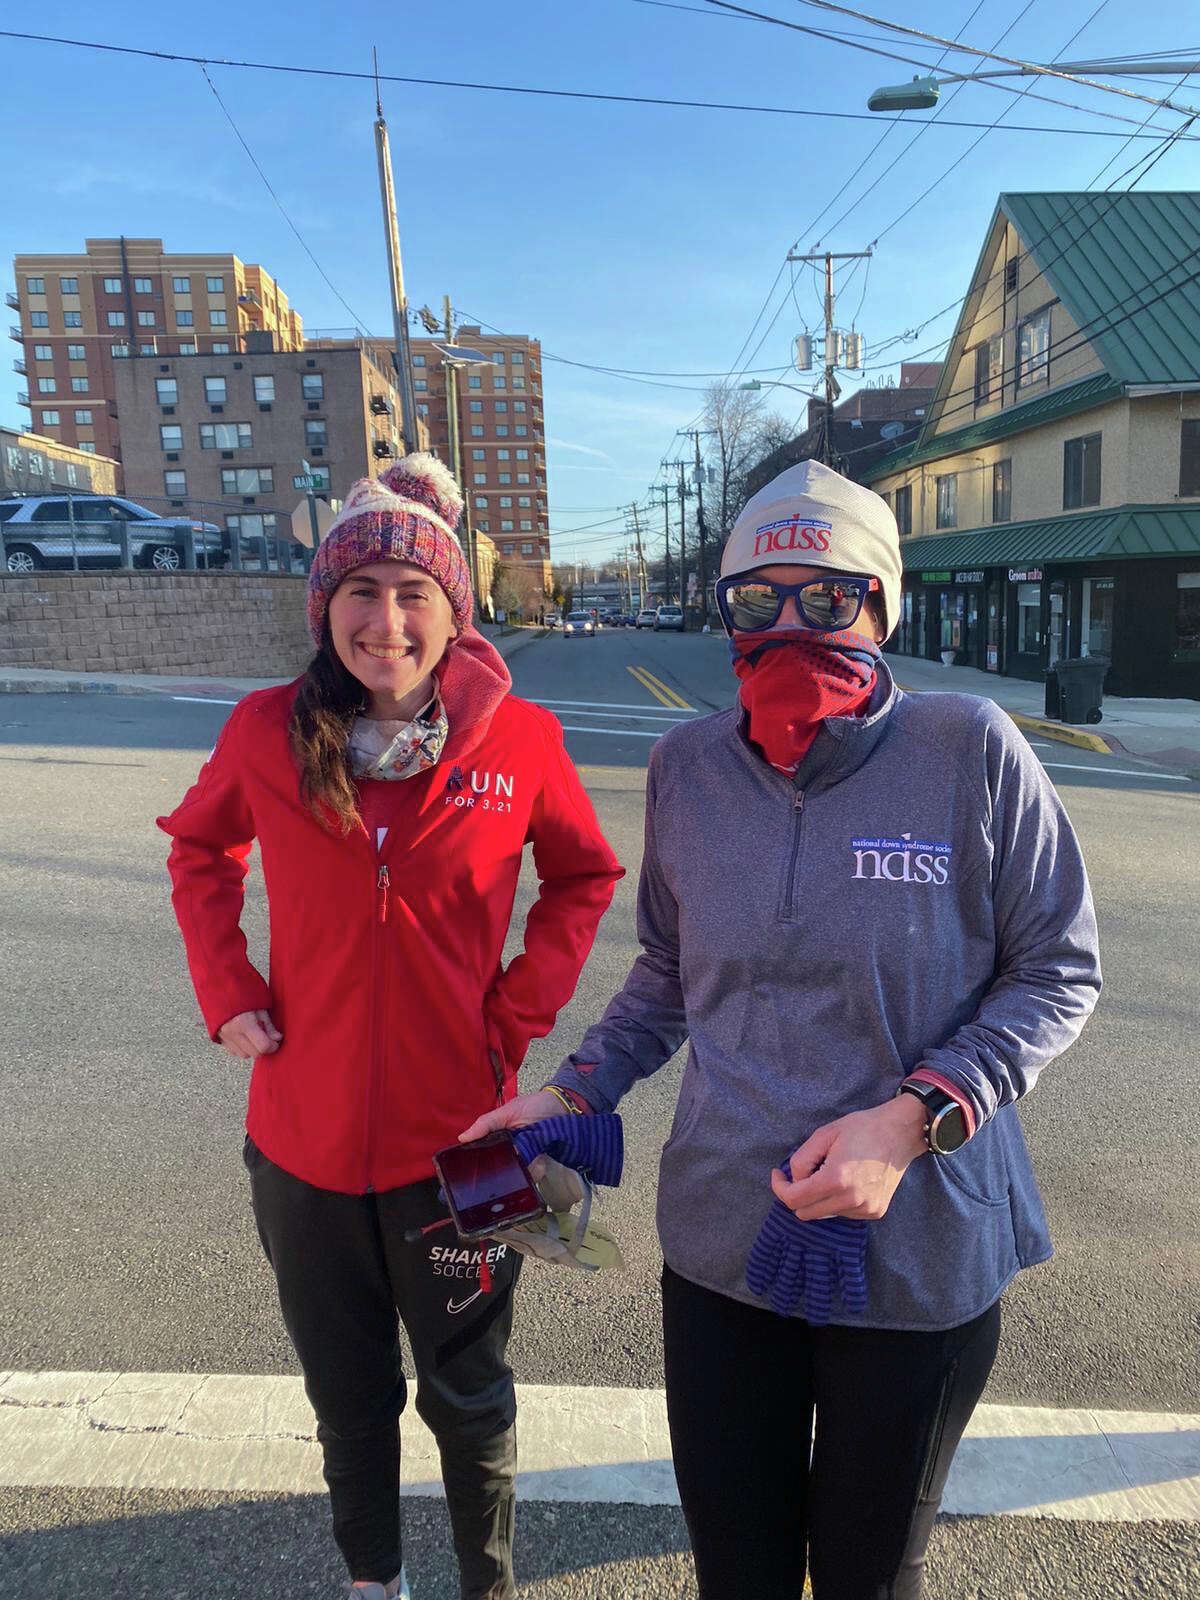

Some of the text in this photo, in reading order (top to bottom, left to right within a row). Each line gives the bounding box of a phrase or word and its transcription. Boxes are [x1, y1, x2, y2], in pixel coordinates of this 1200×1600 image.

[294, 474, 314, 488] MAIN
[752, 513, 832, 557] ndss
[446, 765, 514, 797] RUN
[445, 795, 511, 813] FOR 3.21
[852, 839, 880, 848] national
[881, 840, 900, 848] down
[902, 841, 934, 851] syndrome
[851, 833, 949, 885] ndss
[428, 1243, 507, 1265] SHAKER
